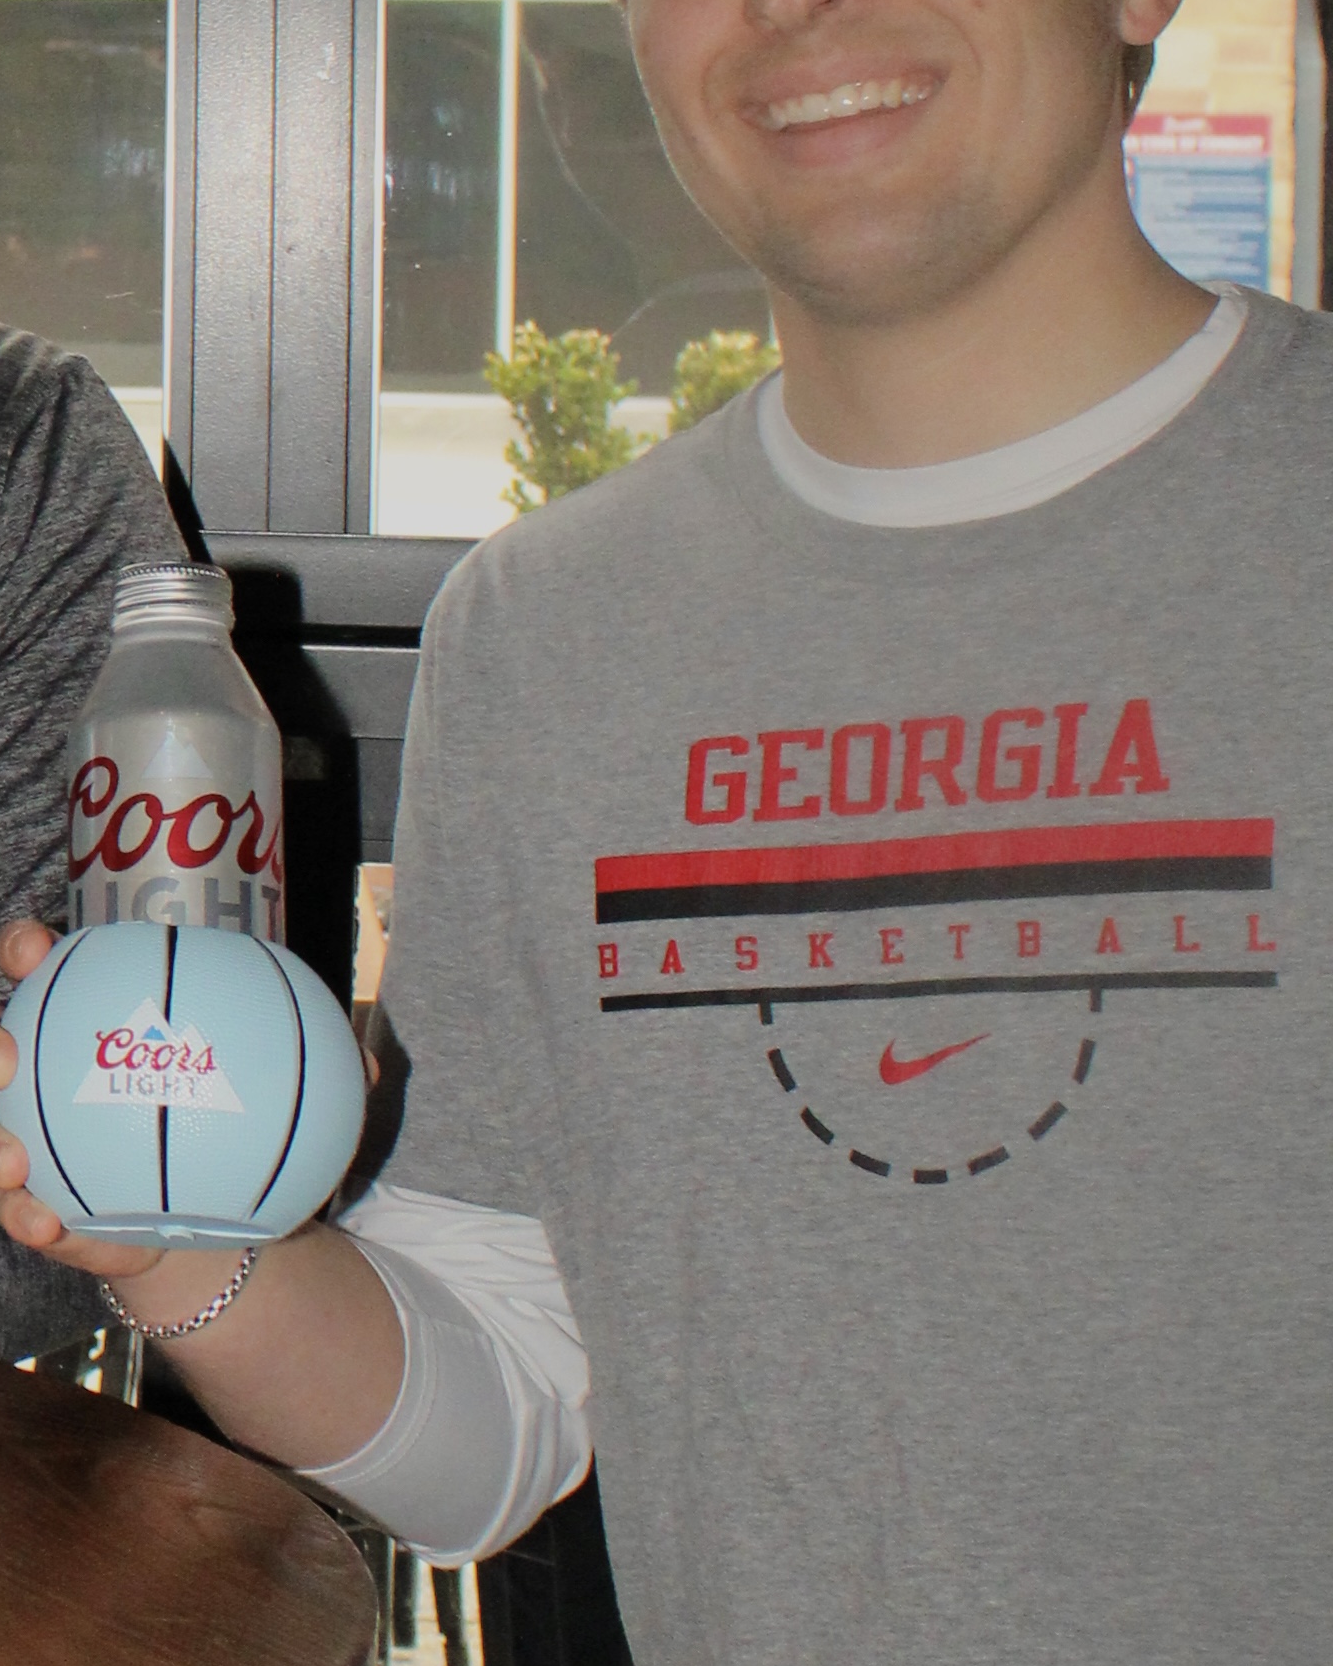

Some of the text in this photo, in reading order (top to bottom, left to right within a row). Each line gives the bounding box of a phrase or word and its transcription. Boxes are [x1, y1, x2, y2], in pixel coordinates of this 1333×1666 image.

[683, 697, 1171, 827] GEORGIA
[67, 755, 283, 883] Coor
[597, 912, 1278, 980] BASKETBALL
[95, 1027, 217, 1075] Coors
[108, 1072, 196, 1097] LIGHT
